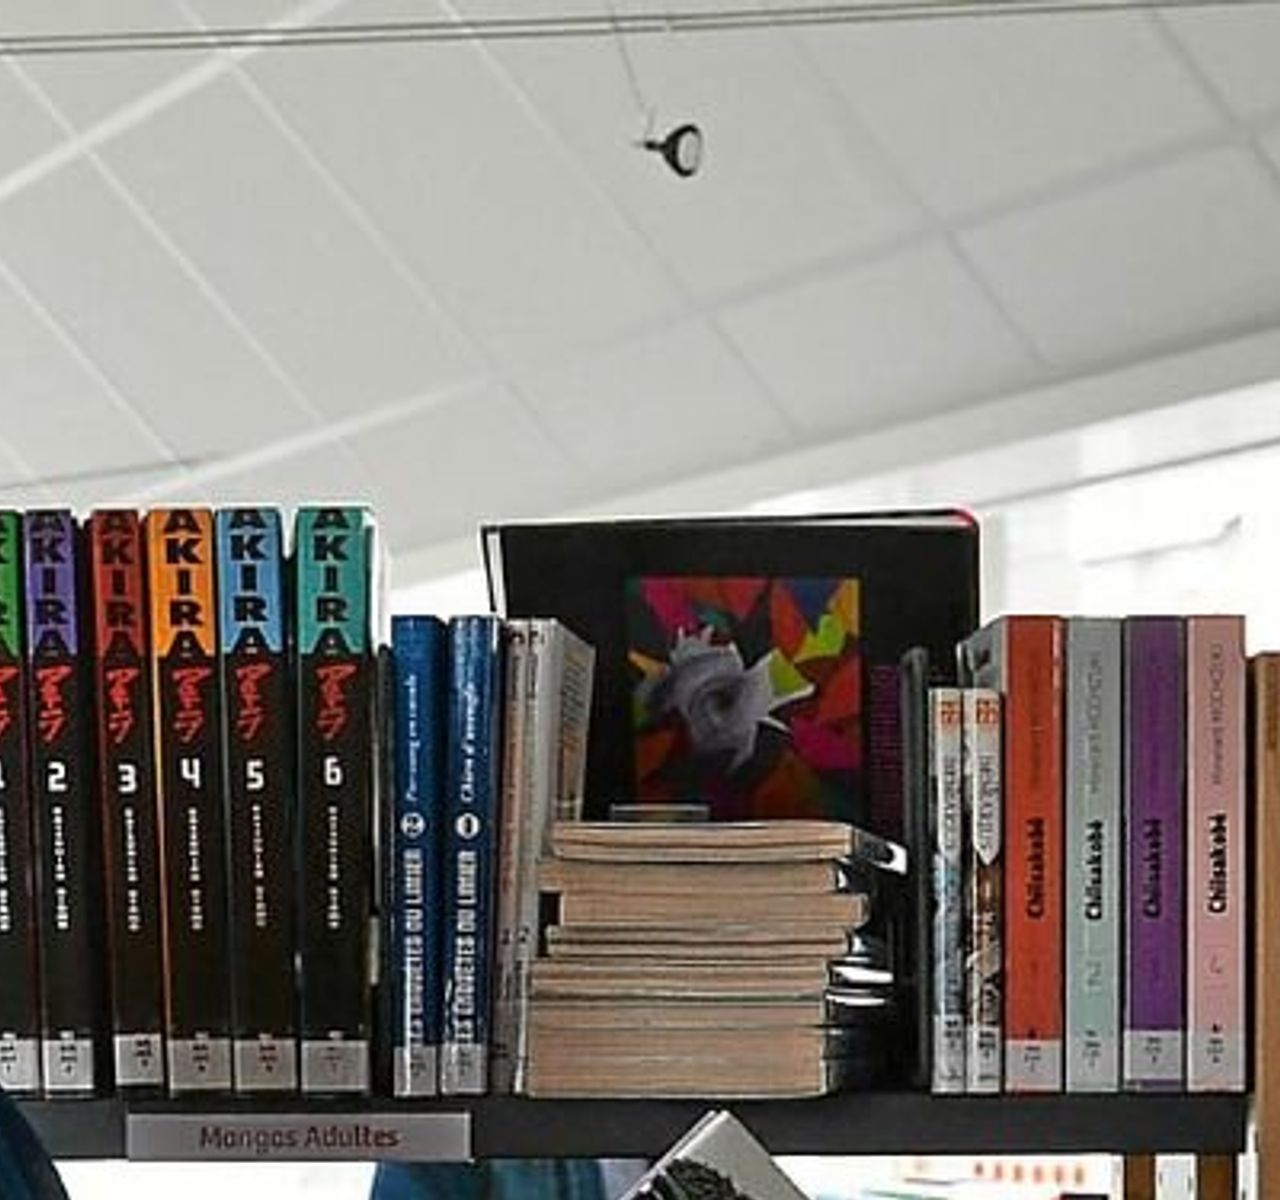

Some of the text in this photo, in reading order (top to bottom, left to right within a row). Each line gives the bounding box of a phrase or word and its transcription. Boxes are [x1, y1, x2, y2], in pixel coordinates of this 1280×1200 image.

[163, 510, 206, 658] AKIRA
[230, 508, 269, 652] AKIRA
[313, 508, 350, 652] AKIRA
[48, 762, 67, 792] 2
[119, 764, 137, 793] 3
[181, 758, 201, 787] 4
[247, 760, 265, 789] 5
[324, 756, 344, 786] 6
[1084, 819, 1104, 920] Chiisakobé
[1207, 813, 1228, 913] Chiisakobé
[200, 1126, 399, 1155] Mangas Adultes
